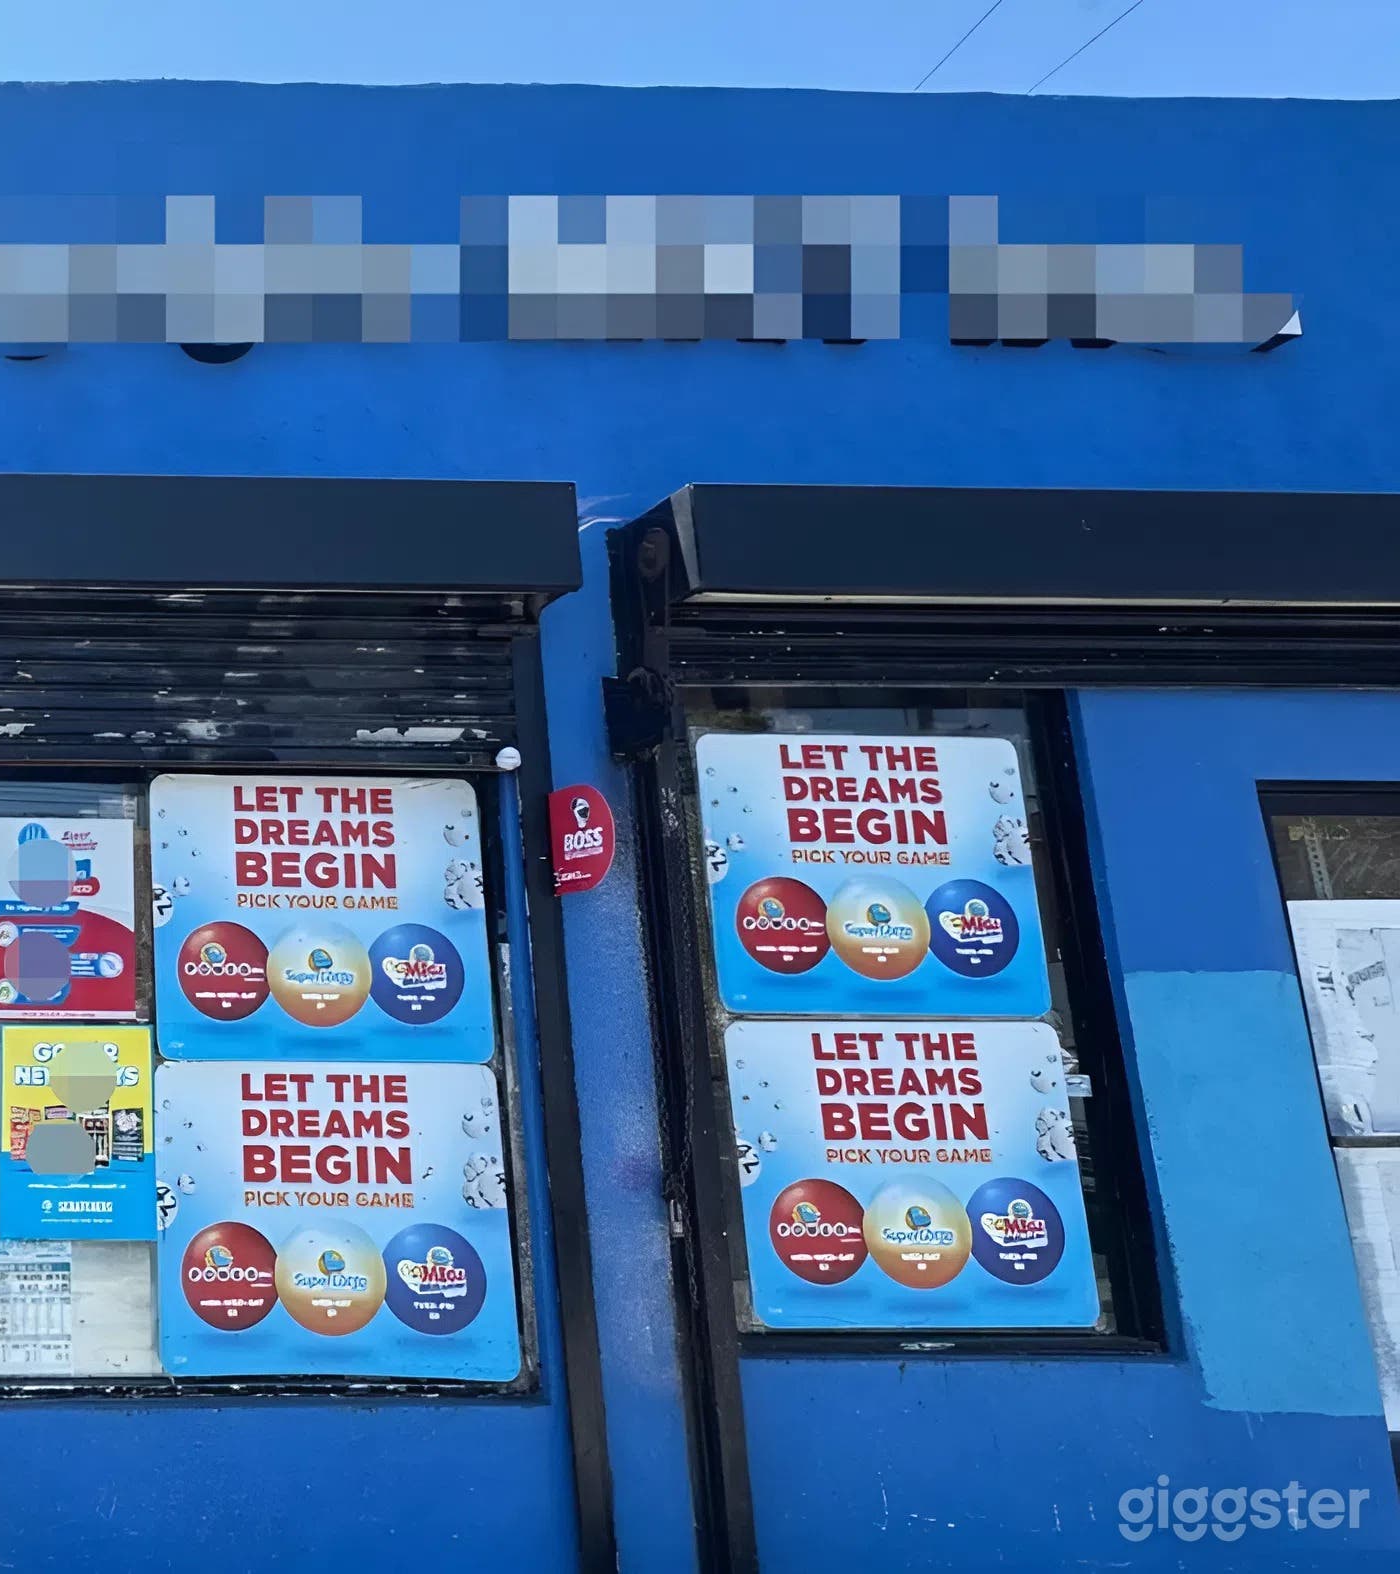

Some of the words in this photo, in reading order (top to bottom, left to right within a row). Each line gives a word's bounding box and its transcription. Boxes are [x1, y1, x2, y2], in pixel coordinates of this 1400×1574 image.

[779, 744, 848, 770] LET
[859, 746, 938, 772] THE
[233, 786, 303, 813] LET
[315, 788, 394, 814] THE
[783, 776, 943, 804] DREAMS
[234, 818, 395, 847] DREAMS
[564, 827, 603, 852] BOSS
[787, 808, 948, 844] BEGIN
[236, 852, 397, 889] BEGIN
[792, 850, 835, 864] PICK
[840, 850, 891, 865] YOUR
[897, 851, 951, 865] GAME
[237, 893, 279, 909] PICK
[285, 894, 337, 909] YOUR
[343, 896, 398, 910] GAME
[811, 1032, 883, 1061] LET
[895, 1033, 977, 1061] THE
[240, 1073, 314, 1102] LET
[326, 1074, 408, 1103] THE
[815, 1067, 982, 1096] DREAMS
[241, 1109, 410, 1140] DREAMS
[820, 1101, 989, 1141] BEGIN
[243, 1144, 412, 1184] BEGIN
[826, 1148, 872, 1163] PICK
[876, 1148, 930, 1163] YOUR
[936, 1148, 992, 1163] GAME
[244, 1191, 289, 1207] PICK
[295, 1191, 349, 1207] YOUR
[356, 1193, 415, 1208] GAME
